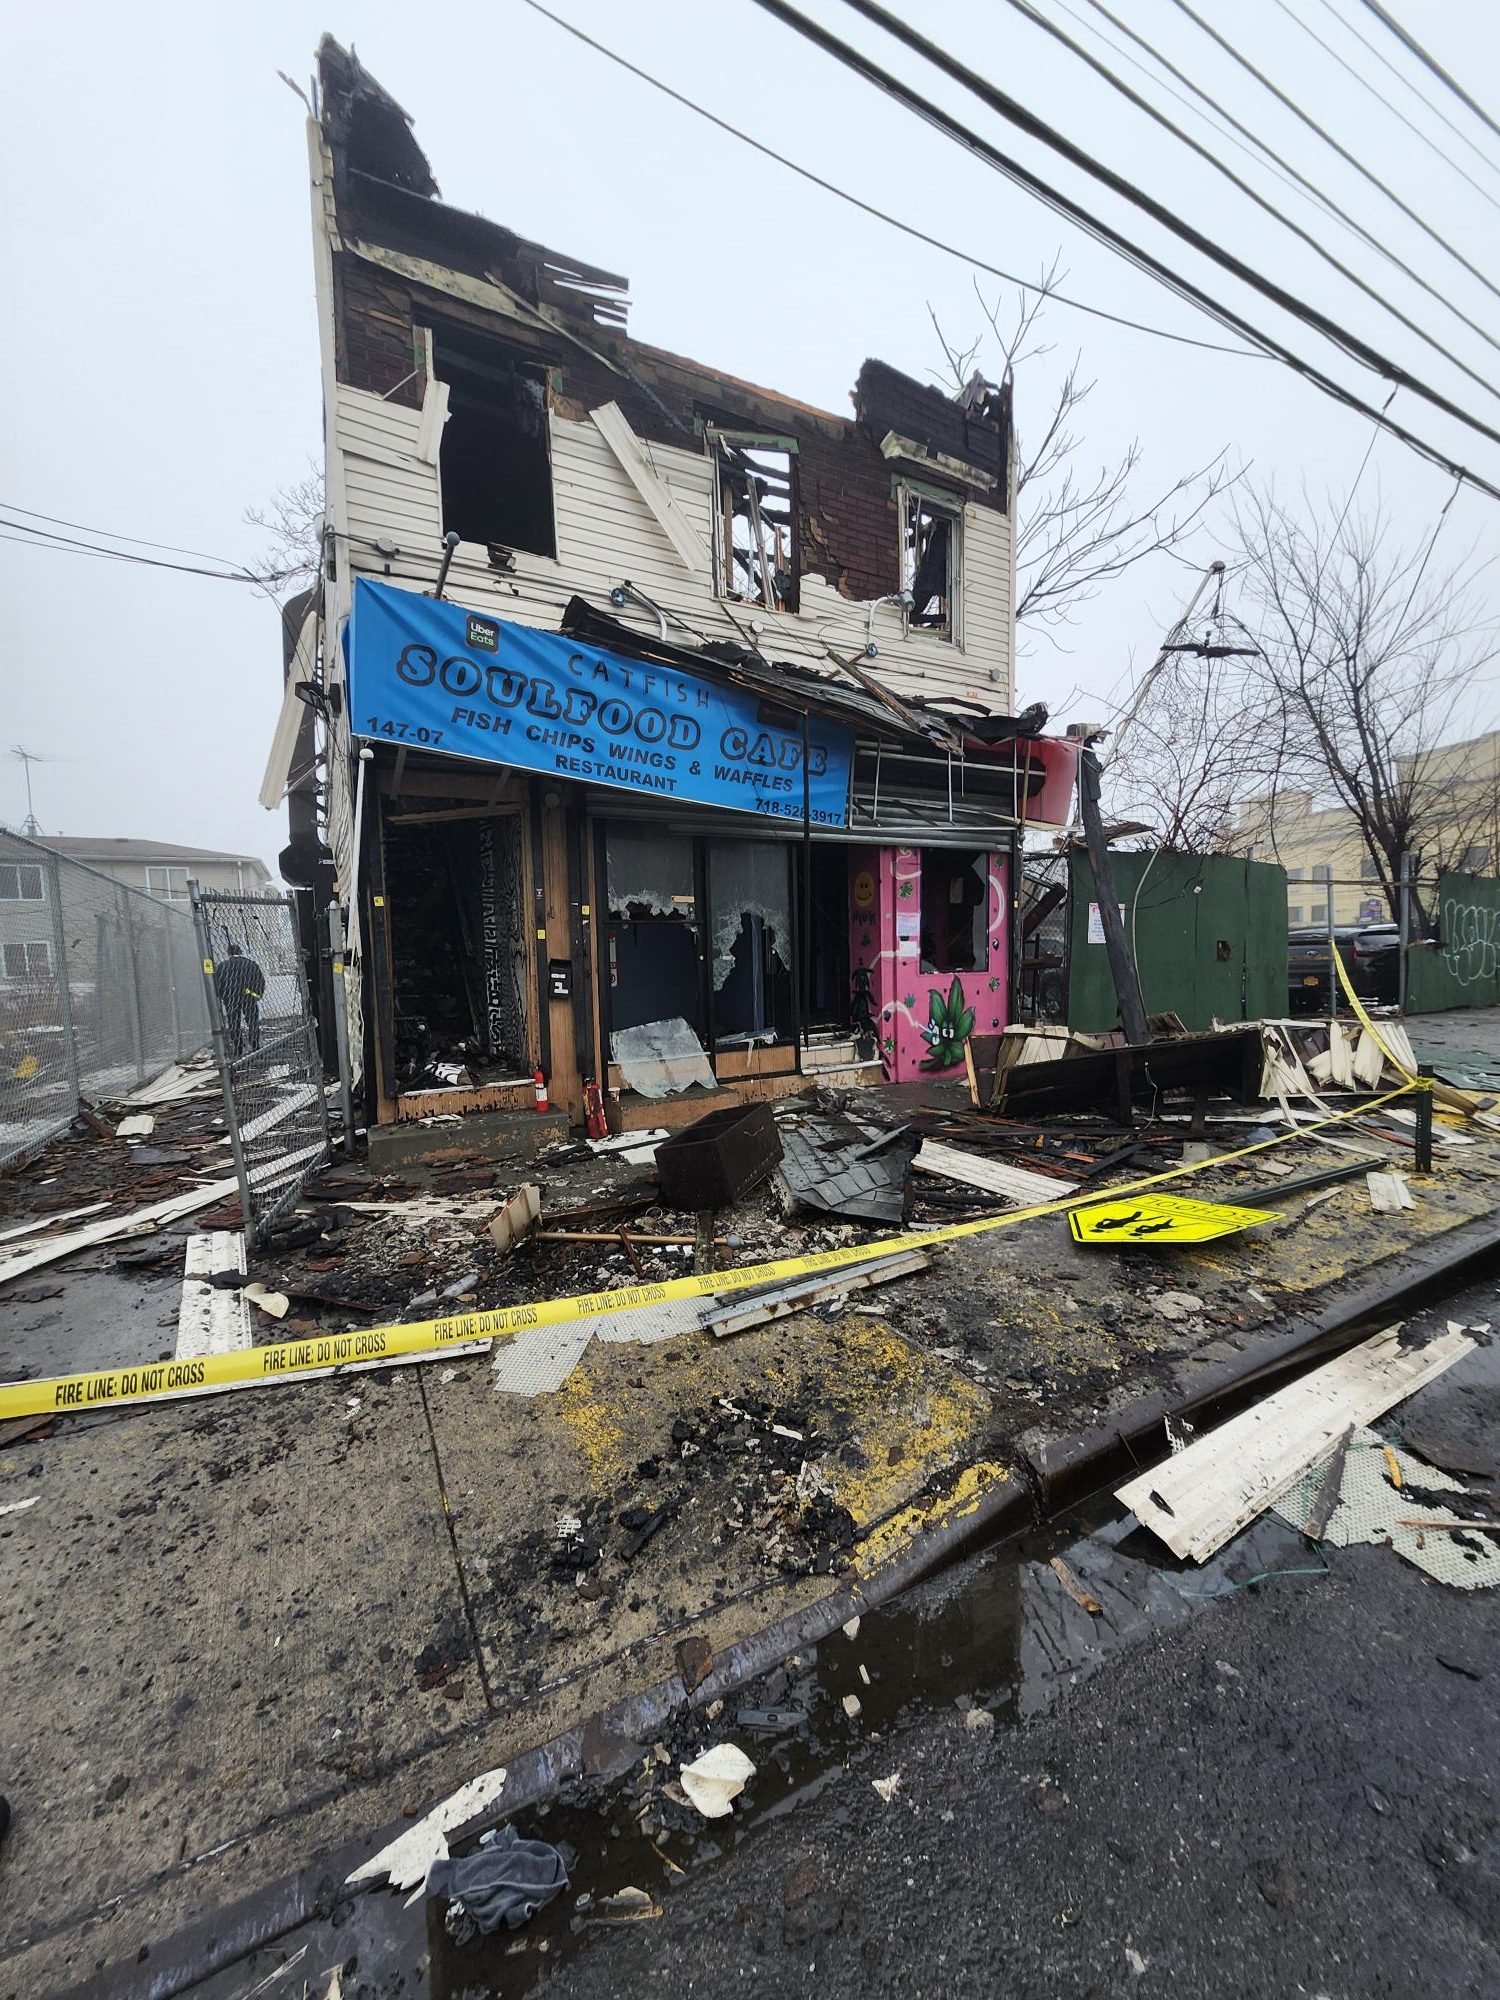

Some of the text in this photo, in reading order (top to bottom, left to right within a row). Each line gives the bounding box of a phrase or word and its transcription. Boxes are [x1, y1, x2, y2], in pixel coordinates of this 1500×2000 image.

[470, 621, 495, 637] Uber
[470, 631, 495, 646] Eats
[568, 654, 709, 709] CATFISH
[396, 643, 828, 776] SOULFOOD CAFE
[367, 717, 444, 745] 147-07
[451, 707, 794, 792] FISH CHIPS WINGS & WAFFLES
[555, 754, 677, 791] RESTAURANT
[1148, 1199, 1262, 1221] SCHOOL
[740, 1268, 754, 1281] NOT
[753, 1265, 776, 1278] CROSS
[577, 1297, 594, 1314] FIRE
[615, 1291, 626, 1307] DO
[626, 1289, 641, 1304] NOT
[642, 1285, 666, 1302] CROSS
[434, 1322, 453, 1341] FIRE
[480, 1315, 491, 1333] DO
[492, 1312, 508, 1330] NOT
[511, 1307, 538, 1327] CROSS
[263, 1349, 285, 1371] FIRE
[317, 1342, 330, 1362] DO
[334, 1338, 352, 1359] NOT
[355, 1333, 386, 1355] CROSS
[55, 1382, 83, 1406] FIRE
[121, 1373, 137, 1395] DO
[142, 1369, 164, 1392] NOT
[168, 1363, 205, 1387] CROSS
